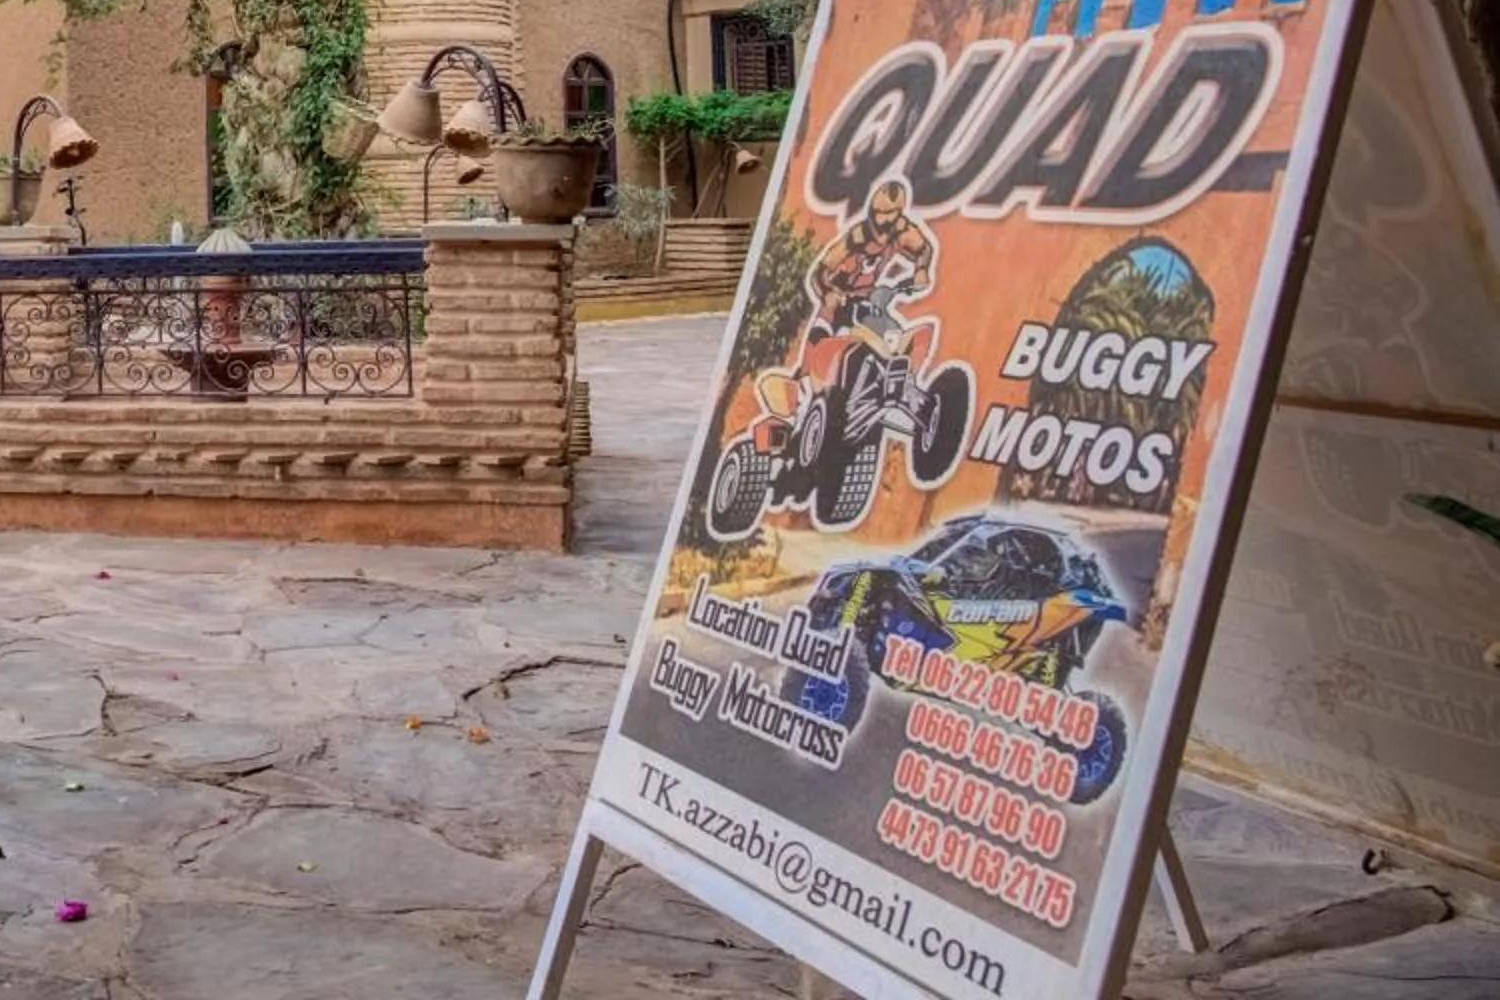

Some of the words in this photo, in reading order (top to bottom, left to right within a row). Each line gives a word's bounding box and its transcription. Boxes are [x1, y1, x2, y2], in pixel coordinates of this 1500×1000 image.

[808, 26, 1278, 218] QUAD
[1002, 323, 1214, 400] BUGGY
[971, 406, 1173, 494] MOTOS
[689, 576, 780, 653] Location
[781, 610, 850, 677] Quad
[654, 640, 717, 714] Buggy
[720, 666, 844, 763] Motocross
[923, 650, 954, 692] 06
[955, 661, 988, 704] 22
[988, 674, 1022, 718] 80
[1023, 686, 1057, 731] 54
[1058, 699, 1095, 745] 48
[909, 702, 970, 755] 0666
[972, 726, 1002, 768] 46
[1003, 738, 1036, 782] 76
[1037, 751, 1074, 798] 36
[897, 753, 928, 795] 06
[928, 765, 959, 808] 57
[957, 778, 990, 821] 87
[989, 791, 1024, 837] 96
[1027, 807, 1063, 855] 90
[638, 761, 1007, 995] TK.azzabi@gmail.com
[971, 843, 1005, 891] 63
